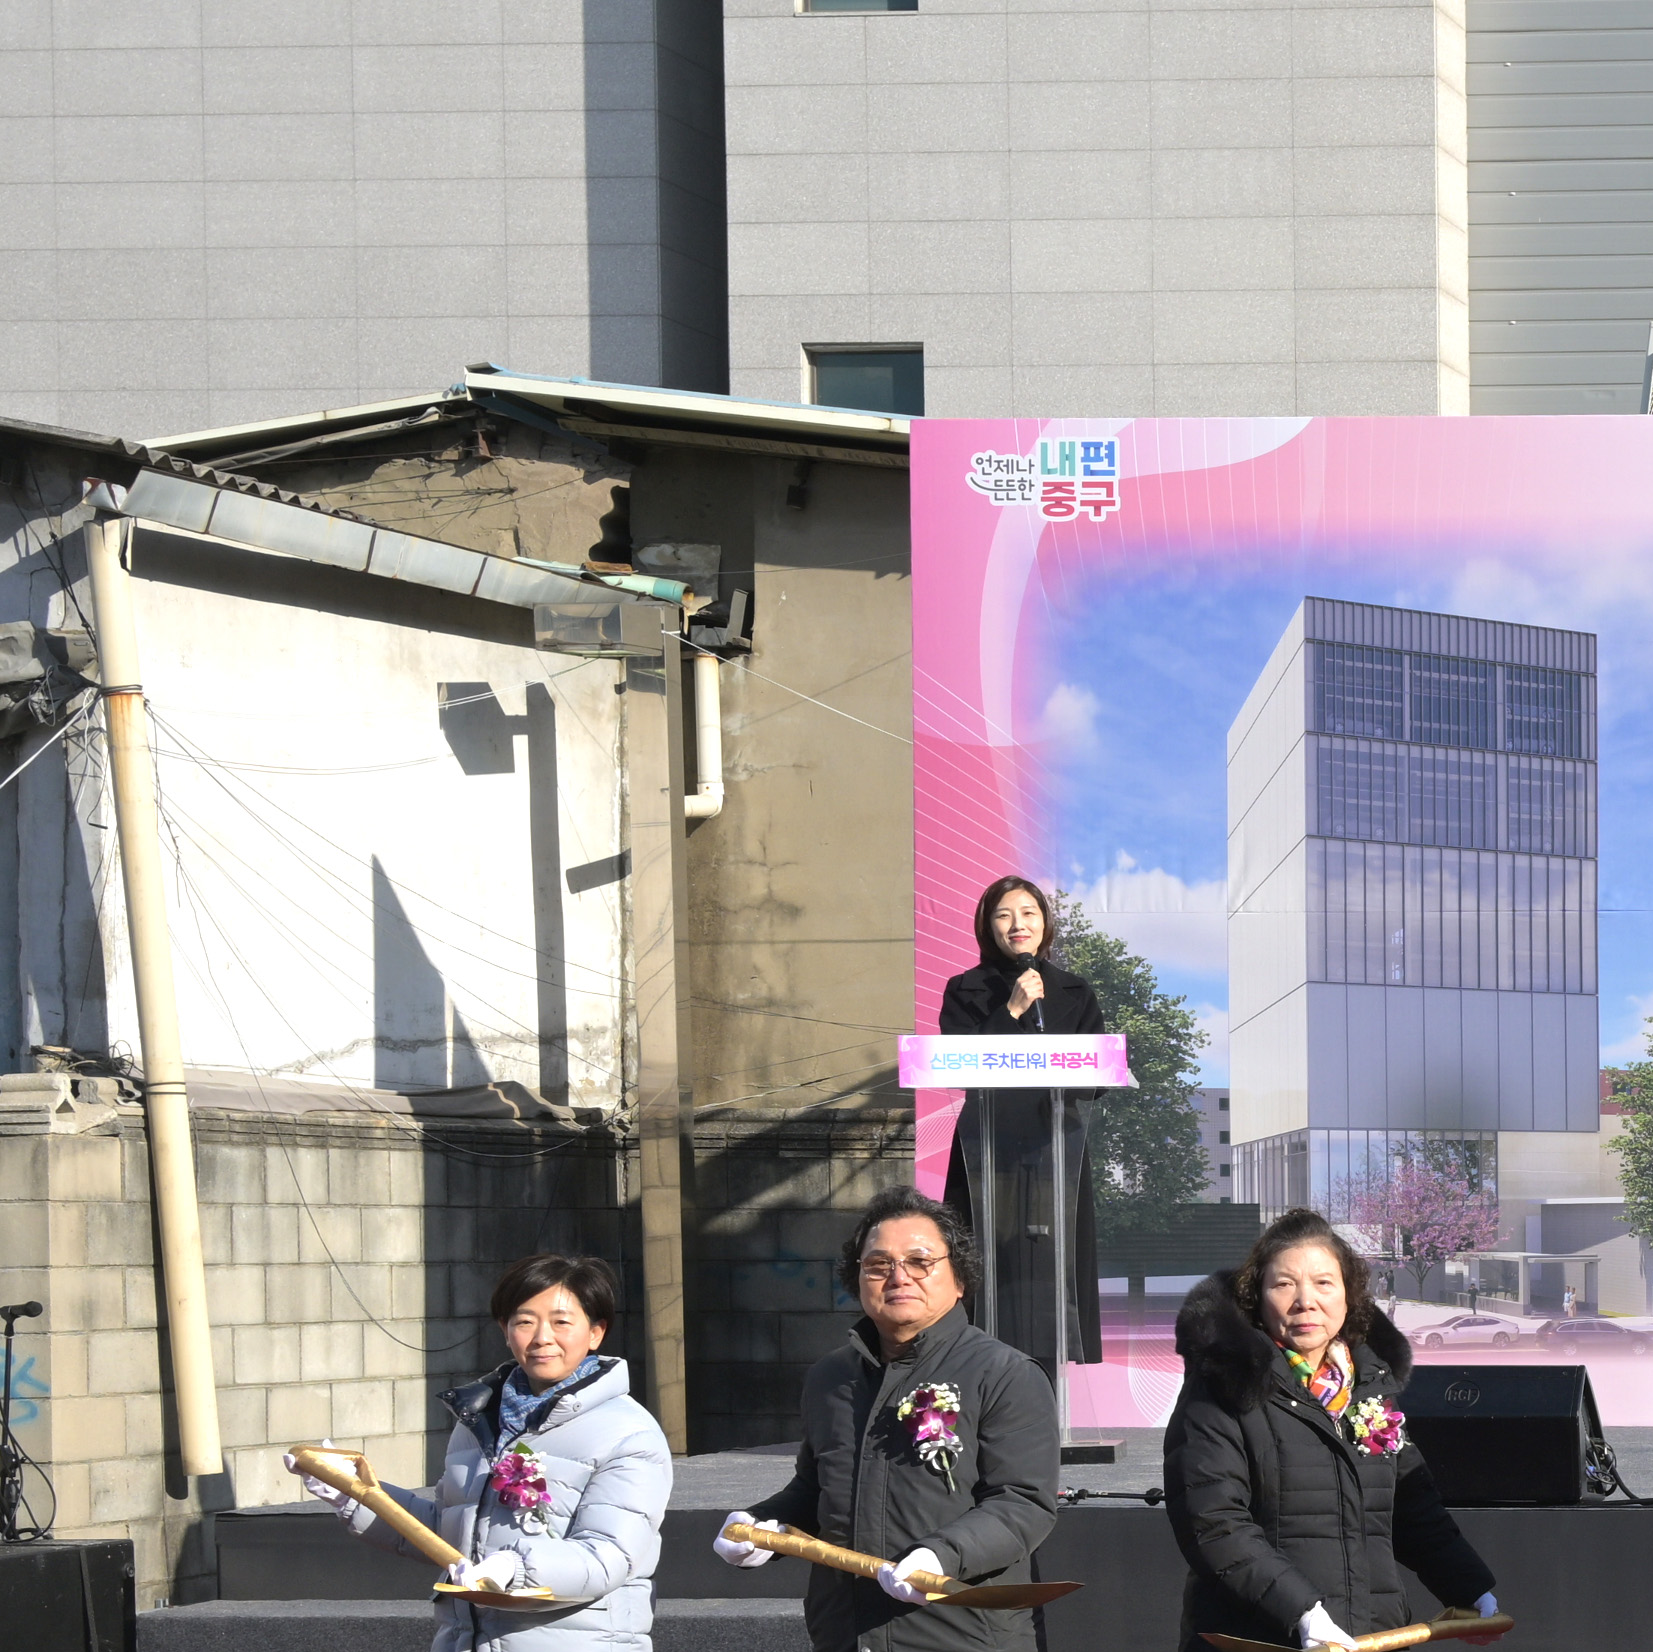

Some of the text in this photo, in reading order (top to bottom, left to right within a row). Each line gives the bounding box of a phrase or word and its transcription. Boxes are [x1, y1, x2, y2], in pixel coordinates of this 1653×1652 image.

[975, 455, 1035, 475] 언제나
[1040, 441, 1116, 476] 내편
[1040, 481, 1116, 517] 중구
[929, 1052, 1099, 1070] 신당역 주차타워 착공식
